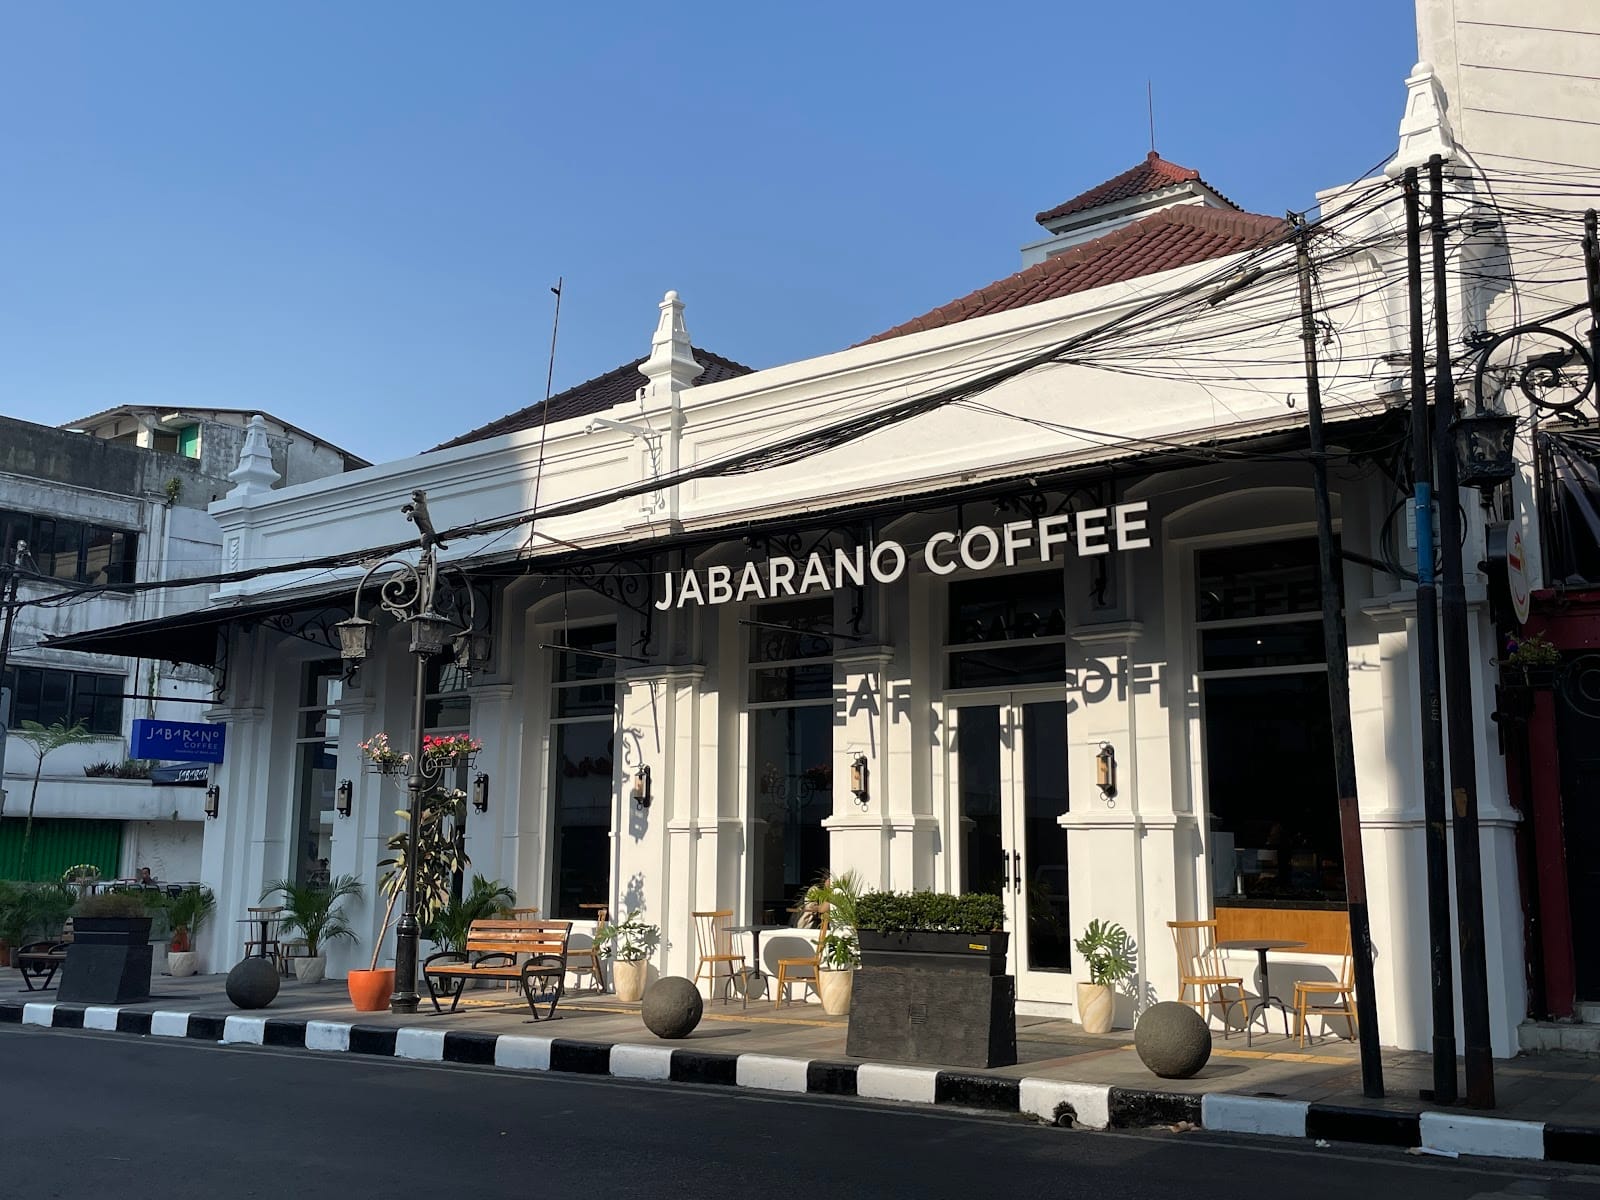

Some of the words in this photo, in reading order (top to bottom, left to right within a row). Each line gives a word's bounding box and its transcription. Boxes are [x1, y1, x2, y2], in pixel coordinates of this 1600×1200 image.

[654, 540, 906, 611] JABARANO
[924, 500, 1152, 575] COFFEE
[146, 727, 219, 742] JABARANO
[183, 741, 218, 750] COFFEE
